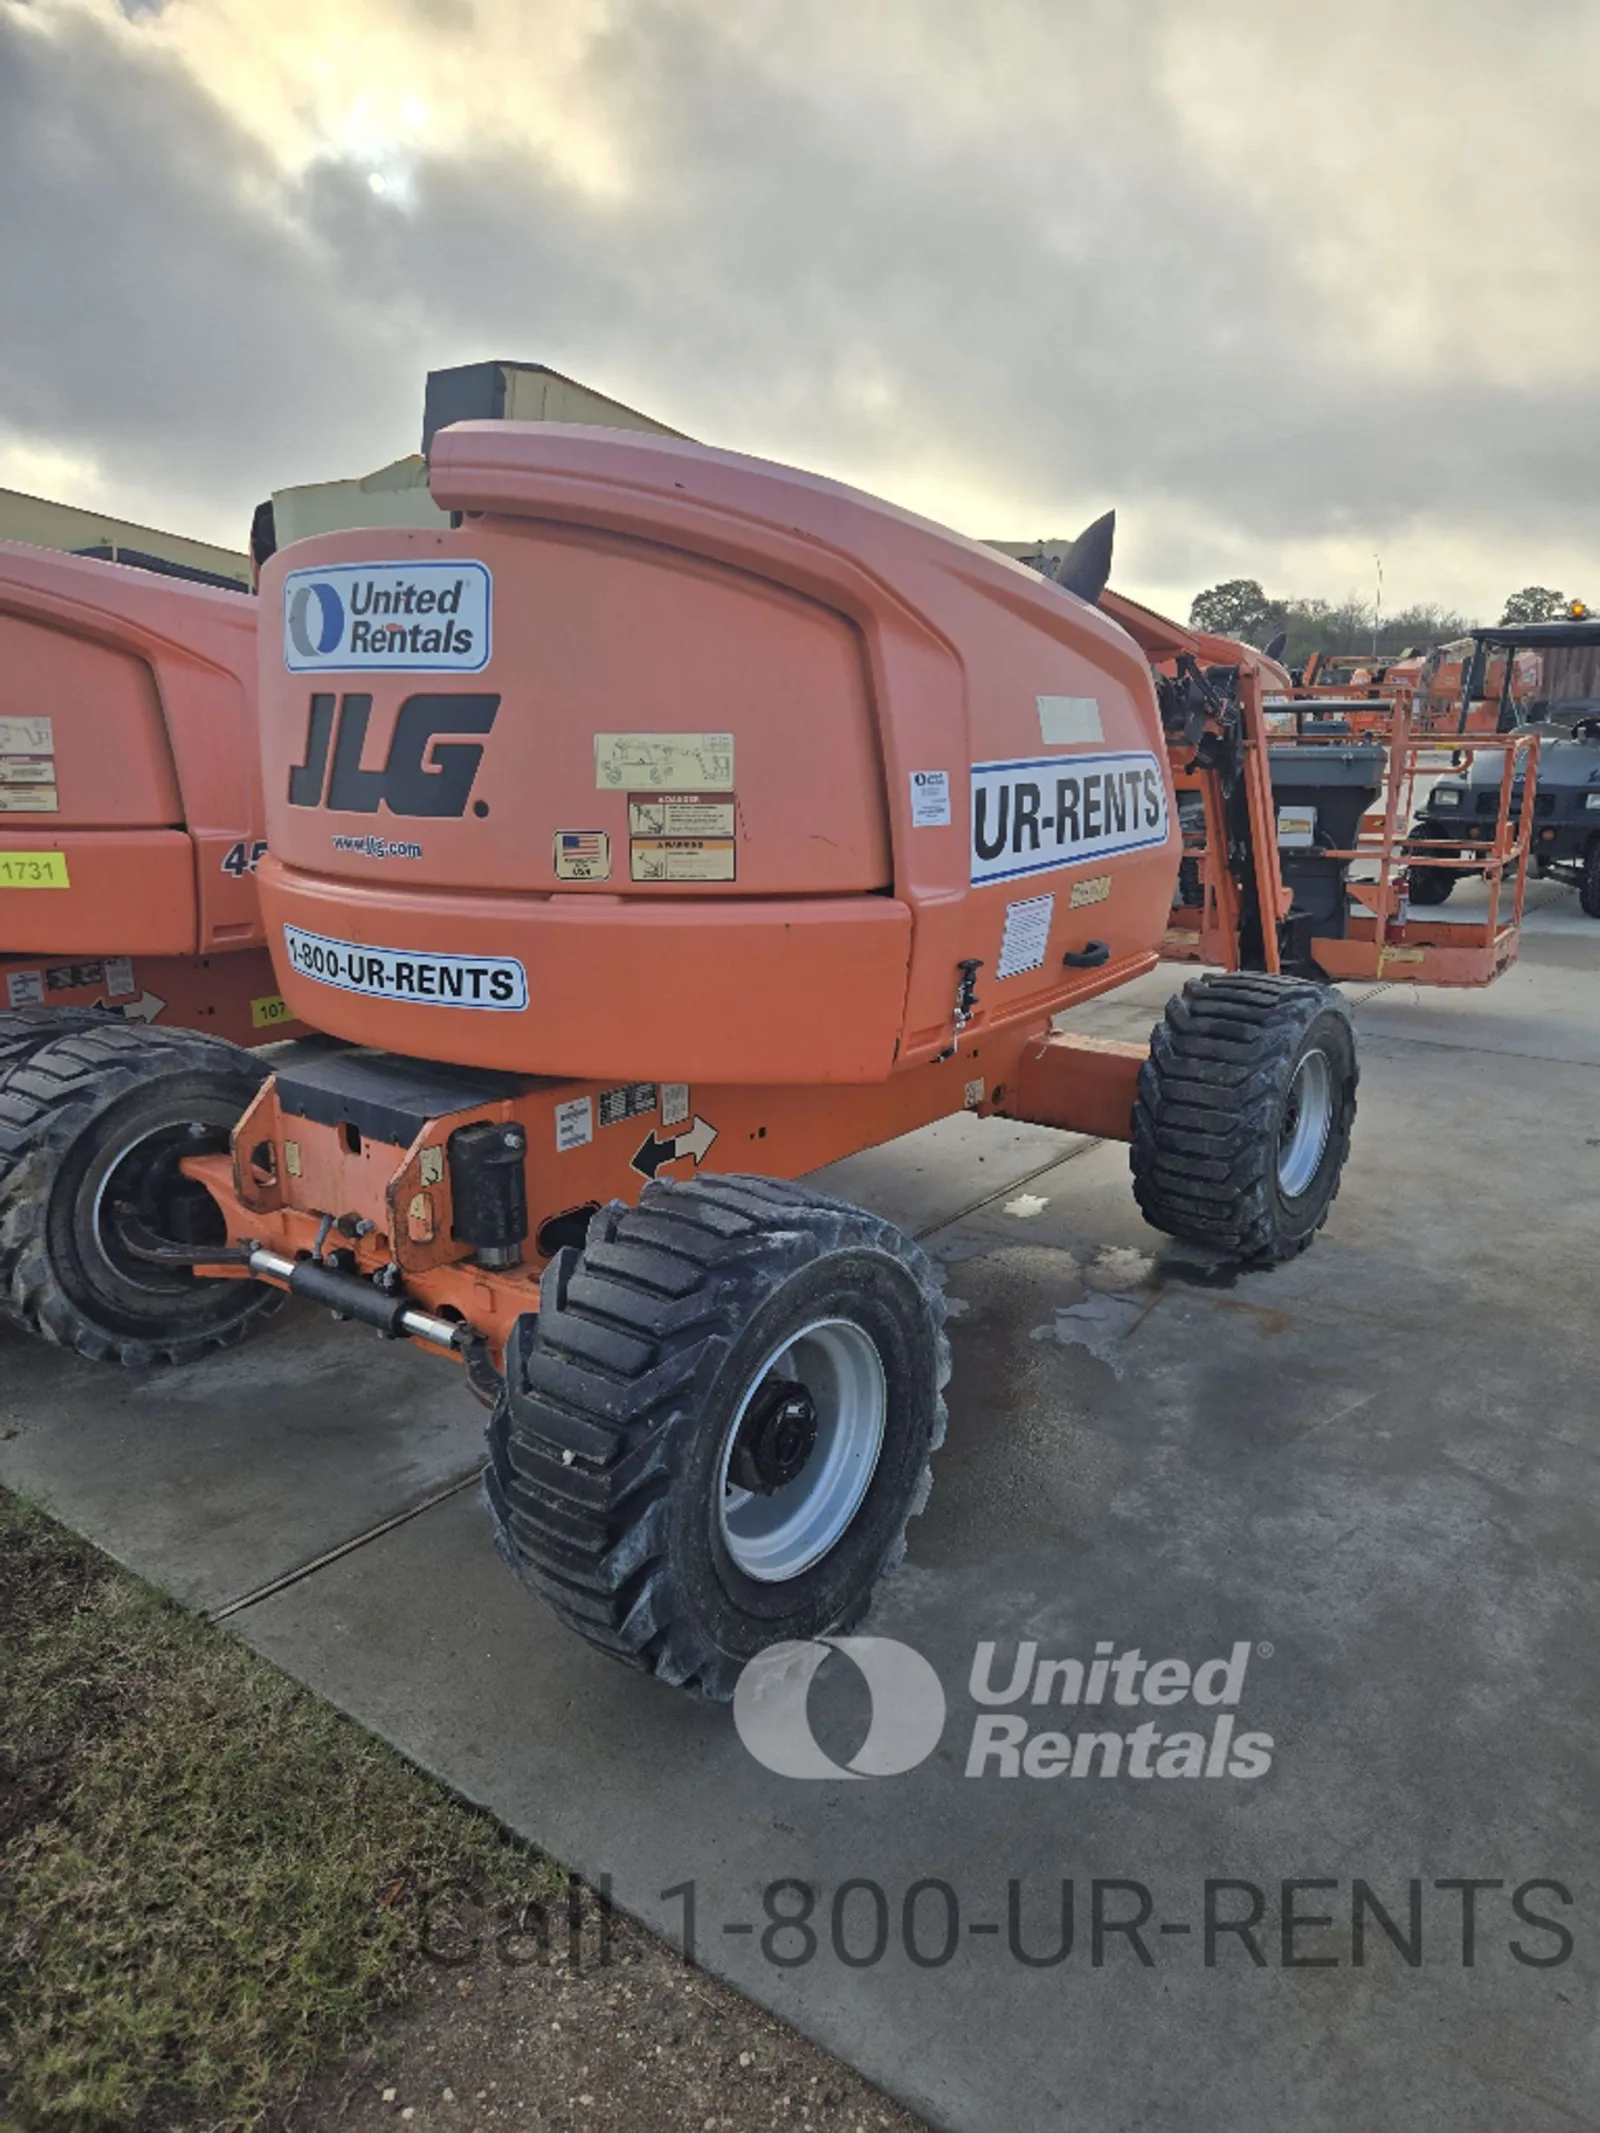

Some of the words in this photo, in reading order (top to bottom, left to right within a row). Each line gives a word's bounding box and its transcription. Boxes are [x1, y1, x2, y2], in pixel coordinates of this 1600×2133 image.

[351, 579, 464, 615] United
[350, 619, 474, 655] Rentals
[974, 768, 1160, 861] UR-RENTS
[332, 835, 423, 858] www.jlg.com
[2, 861, 54, 881] 1731
[289, 937, 514, 1001] 1-800-UR-RENTS
